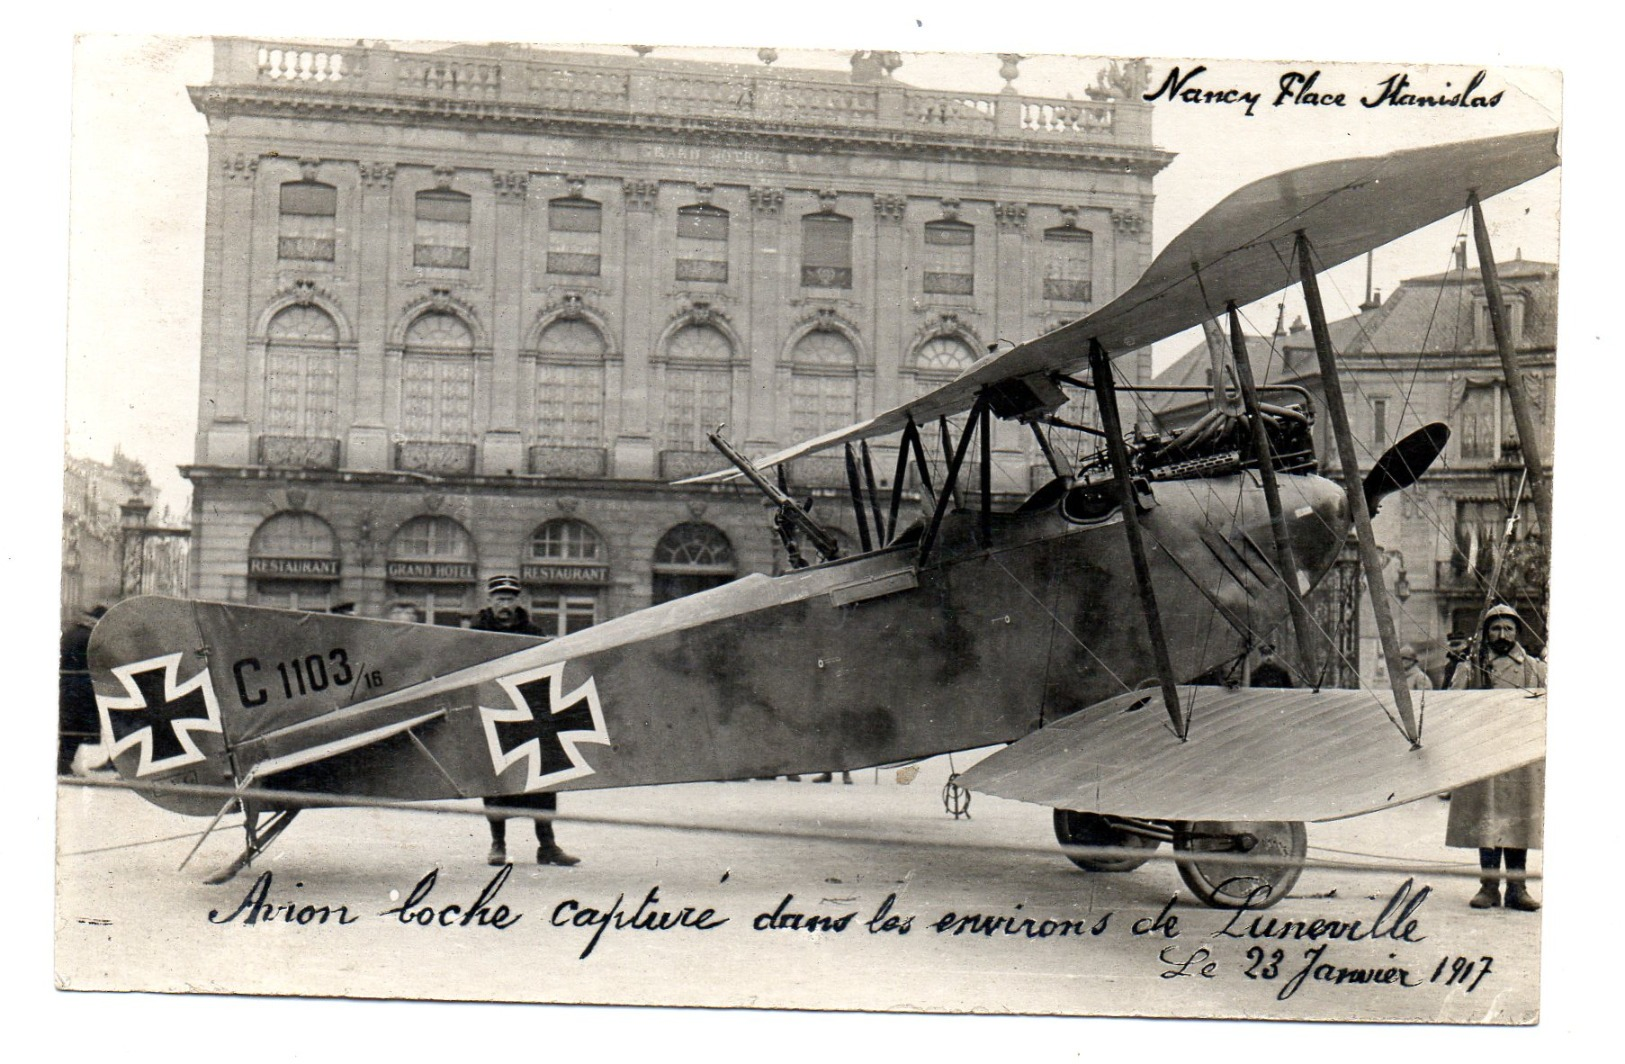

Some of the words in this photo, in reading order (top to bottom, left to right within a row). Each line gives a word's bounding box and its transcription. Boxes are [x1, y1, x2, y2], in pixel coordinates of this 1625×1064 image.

[1143, 66, 1262, 116] Nancy
[1360, 69, 1506, 110] Stanislas
[251, 559, 339, 576] RESTAURANT
[388, 563, 433, 578] GRAND
[436, 564, 474, 580] HOTEL
[523, 566, 607, 583] RESTAURANT
[232, 657, 268, 709] C
[208, 870, 358, 925] Avion
[378, 863, 523, 932] boche
[753, 893, 858, 932] dans
[864, 892, 914, 937] les
[925, 903, 1110, 938] environs
[1131, 889, 1182, 939] de
[1159, 945, 1219, 980] Le
[1244, 946, 1281, 981] 23
[1276, 942, 1424, 1001] Janvier
[1430, 955, 1495, 993] 1917
